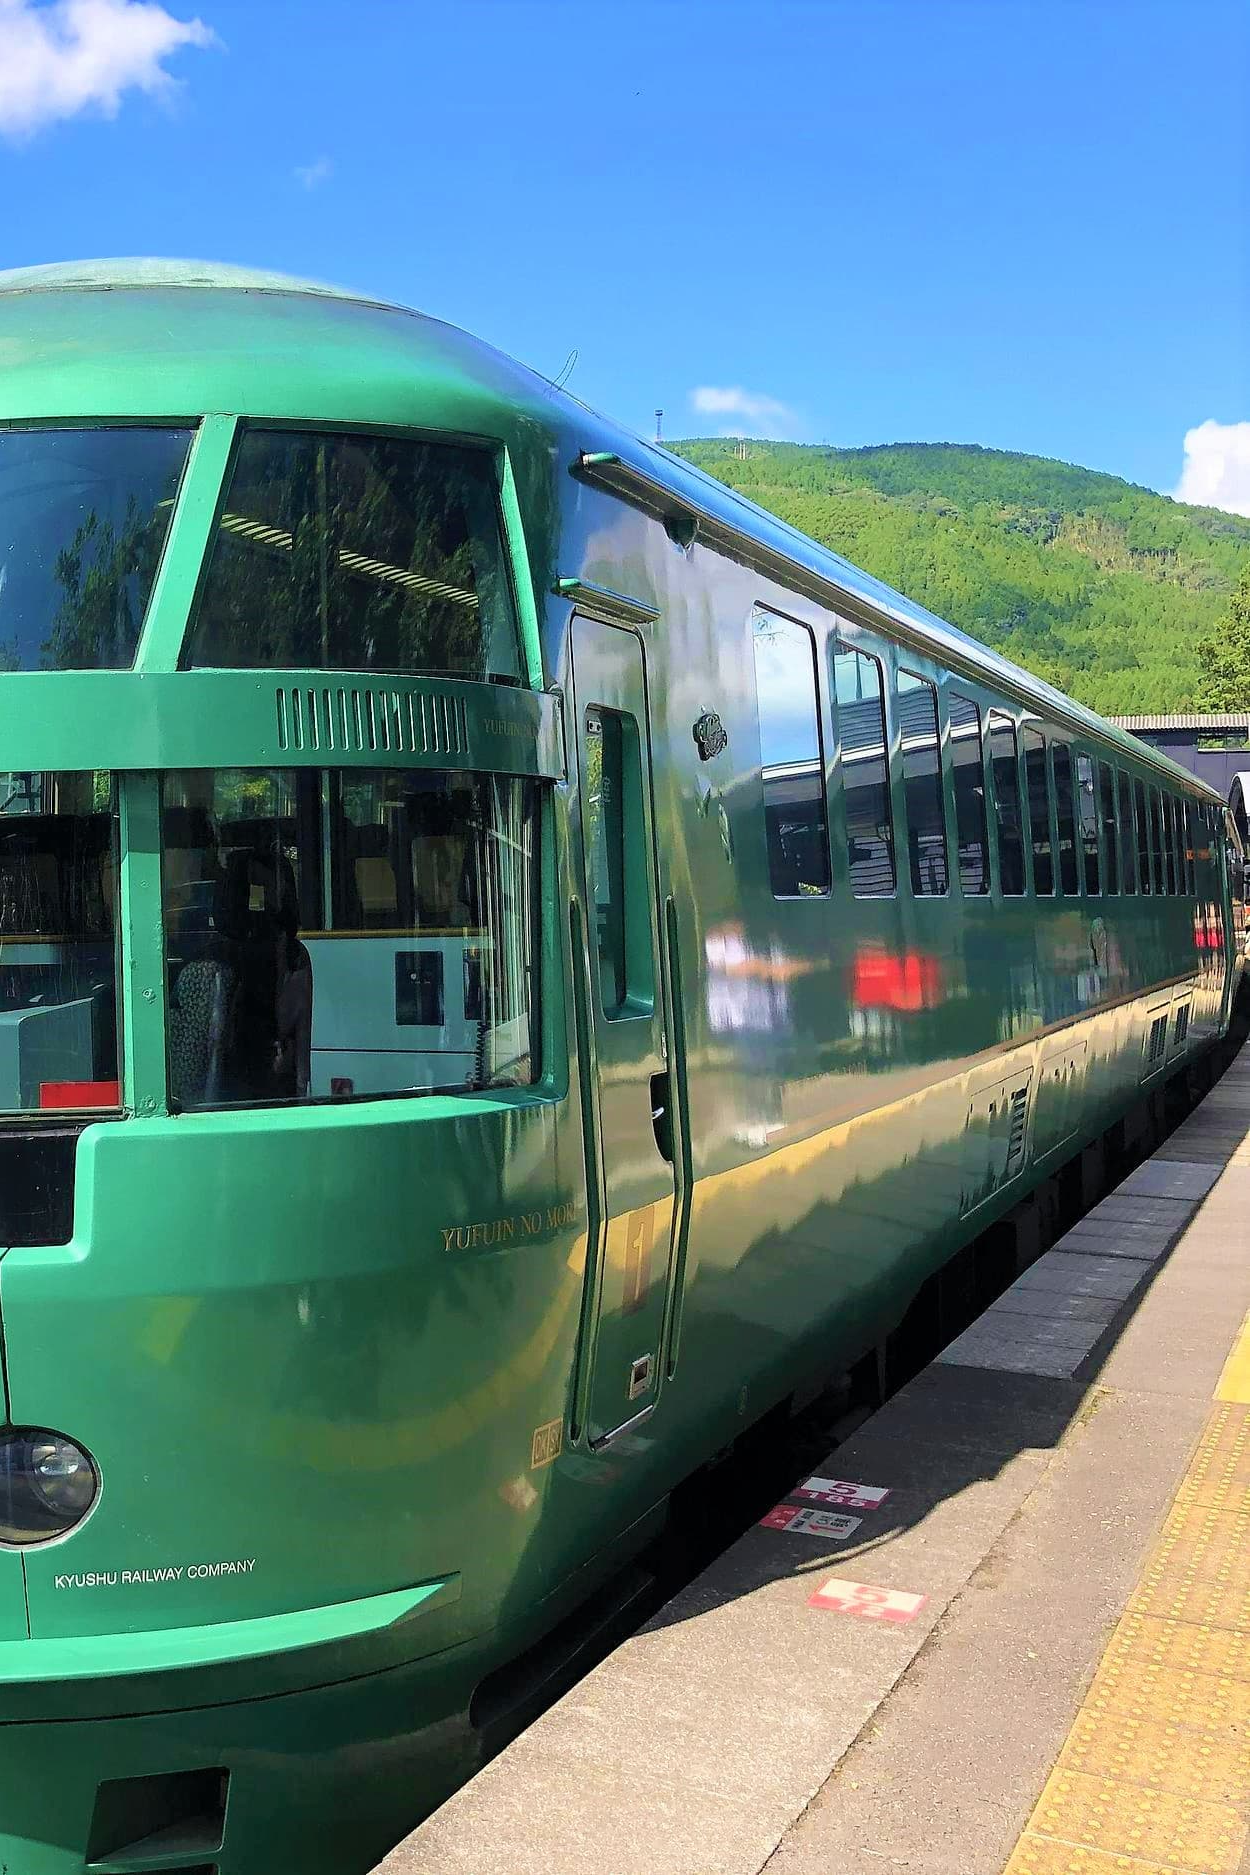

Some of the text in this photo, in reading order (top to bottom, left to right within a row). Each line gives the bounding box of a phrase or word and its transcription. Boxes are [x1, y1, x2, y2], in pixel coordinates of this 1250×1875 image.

[440, 1217, 515, 1252] YUFUIN
[520, 1211, 543, 1237] NO
[828, 1482, 861, 1496] 5
[807, 1491, 869, 1508] 185
[54, 1558, 257, 1590] KYUSHU RAILWAY COMPANY
[850, 1585, 889, 1605] 5
[837, 1601, 887, 1617] 72
